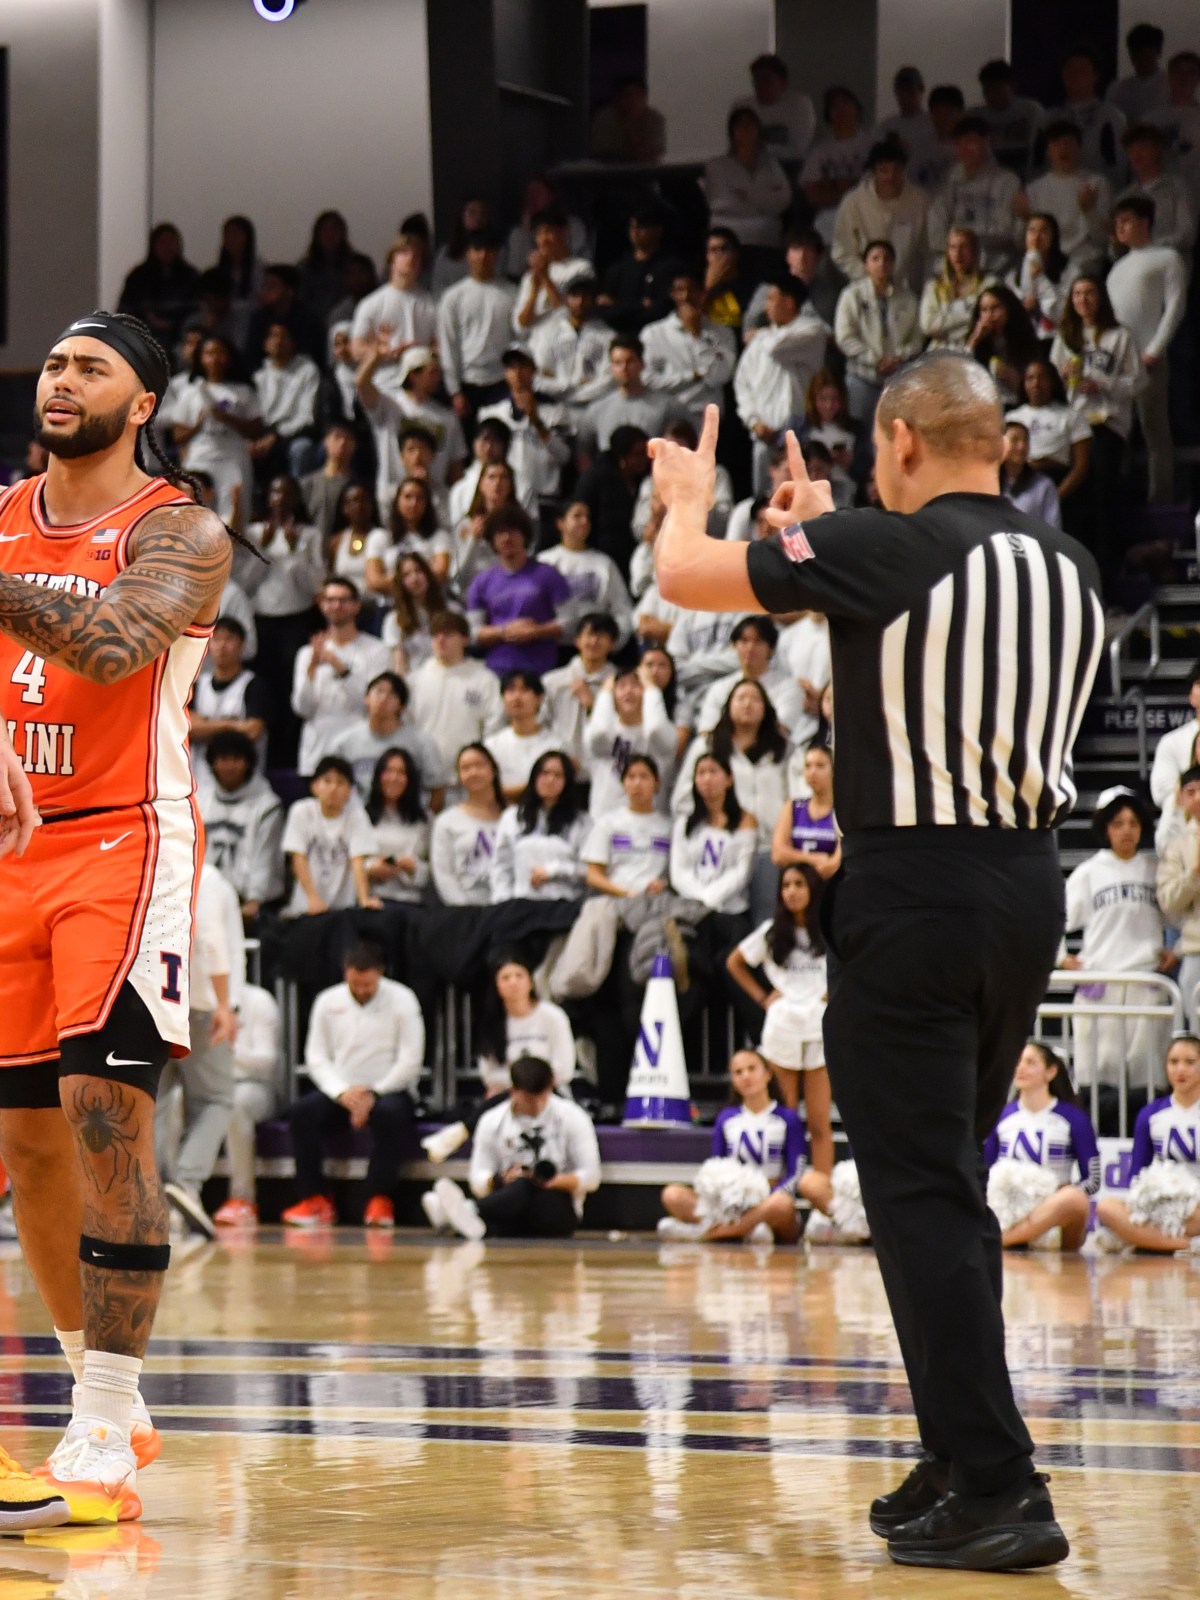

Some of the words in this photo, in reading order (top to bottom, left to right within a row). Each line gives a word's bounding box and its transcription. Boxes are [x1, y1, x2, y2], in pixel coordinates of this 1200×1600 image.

[11, 650, 46, 704] 4
[160, 950, 182, 1005] I
[737, 1130, 765, 1166] N
[1013, 1128, 1044, 1165] N
[1167, 1127, 1196, 1162] N
